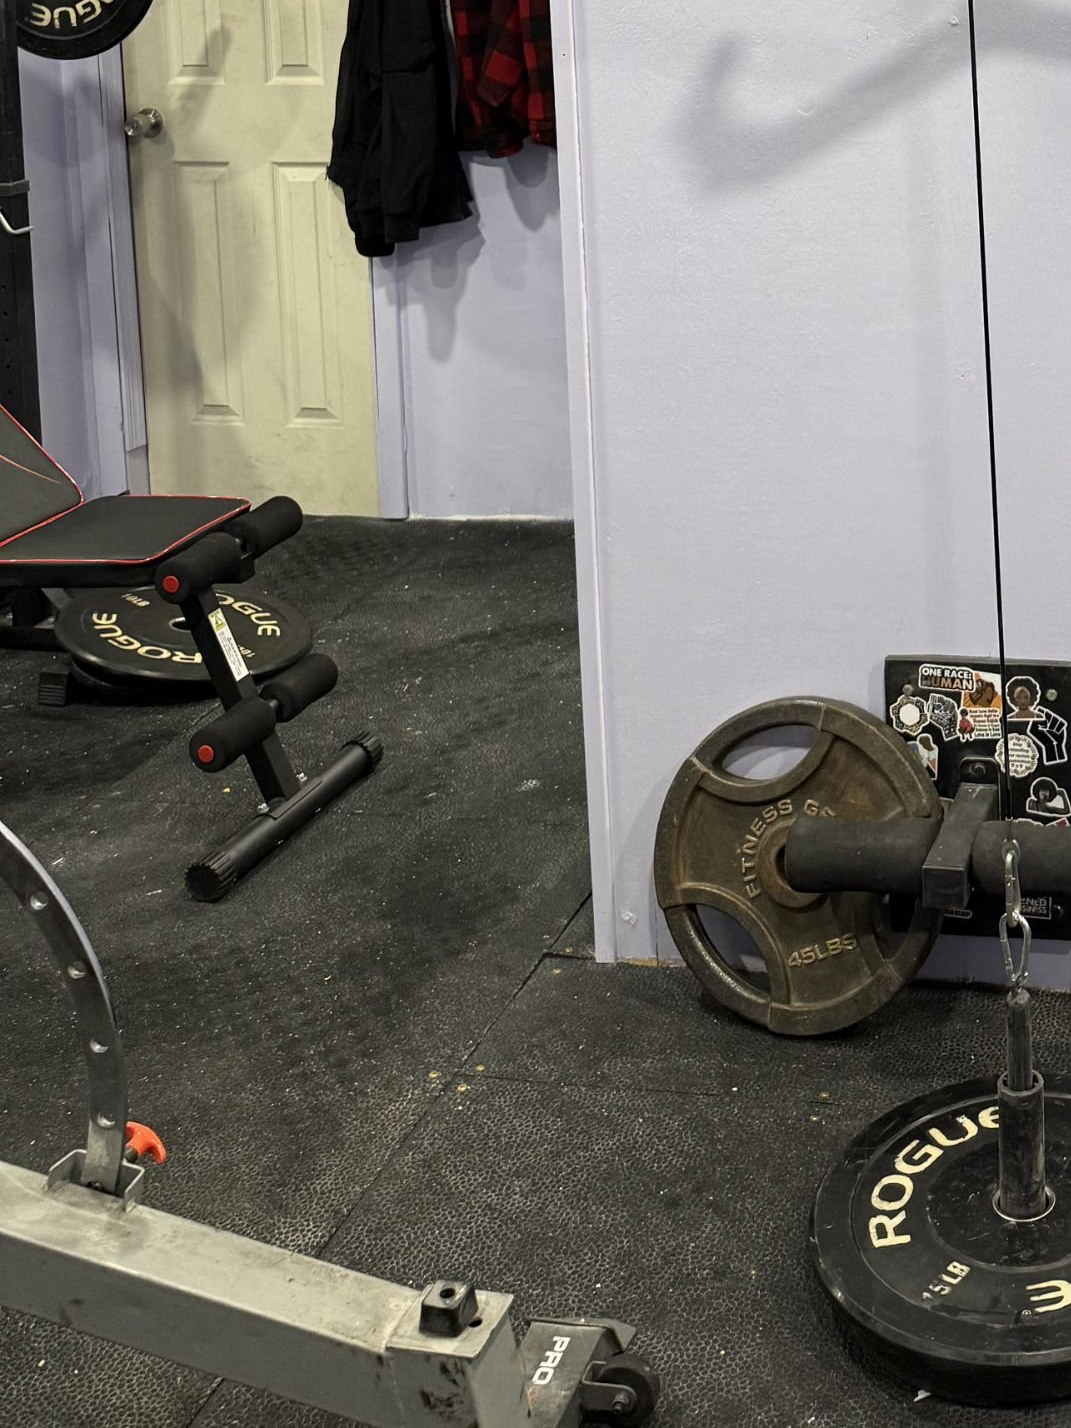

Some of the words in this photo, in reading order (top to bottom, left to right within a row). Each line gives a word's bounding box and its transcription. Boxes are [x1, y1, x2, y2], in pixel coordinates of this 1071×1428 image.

[215, 593, 281, 637] OGUE
[92, 612, 203, 664] ROGUE
[922, 667, 942, 677] ONE
[944, 669, 972, 679] RACE:
[922, 676, 973, 690] HUMAN
[737, 799, 793, 899] FITNESS
[787, 934, 858, 968] 45LBS
[532, 1336, 571, 1385] PRO
